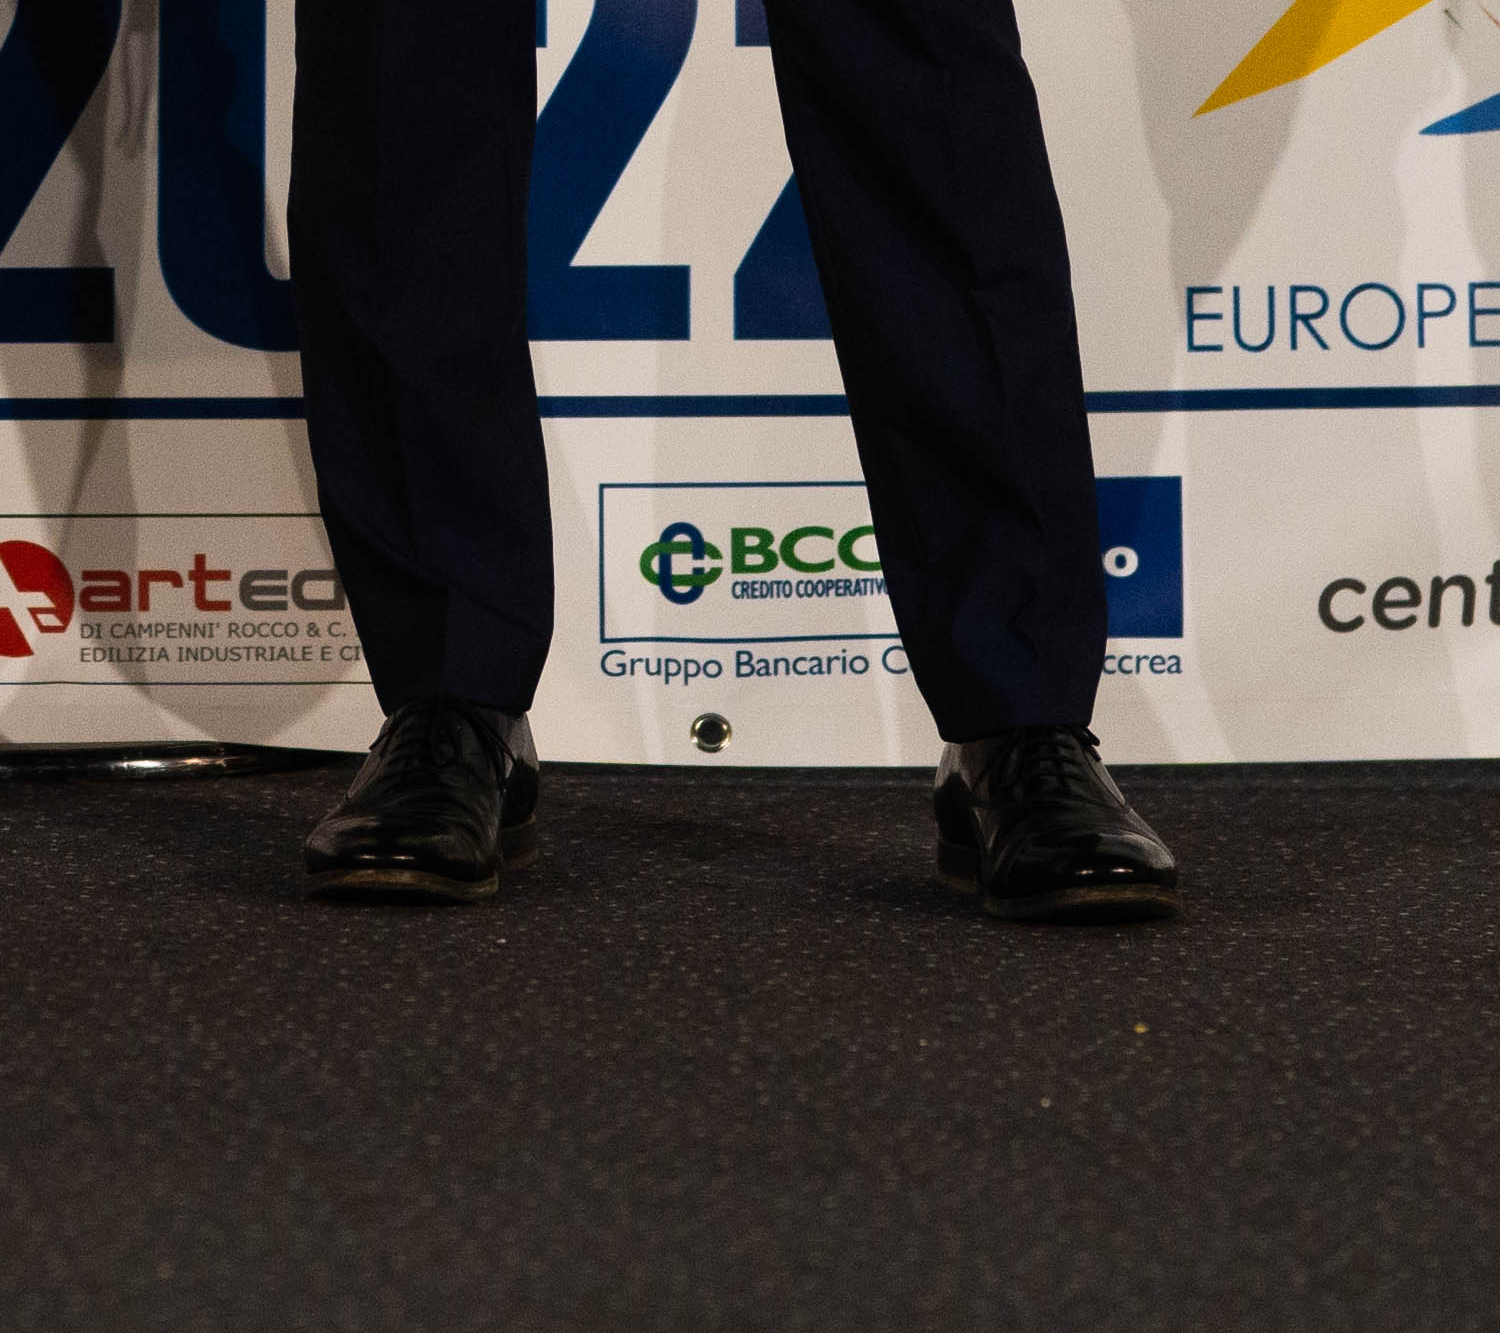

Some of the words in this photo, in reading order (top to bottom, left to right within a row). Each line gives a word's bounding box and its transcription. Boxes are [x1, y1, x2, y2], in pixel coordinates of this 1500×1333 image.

[731, 579, 793, 600] CREDITO
[80, 621, 102, 640] DI
[111, 621, 220, 640] CAMPENNI'
[229, 621, 299, 639] ROCCO
[306, 621, 322, 638] &
[327, 621, 347, 638] C.
[80, 645, 170, 664] EDILIZIA
[178, 645, 313, 662] INDUSTRIALE
[321, 645, 333, 662] E
[600, 648, 724, 686] Gruppo
[735, 645, 870, 679] Bancario
